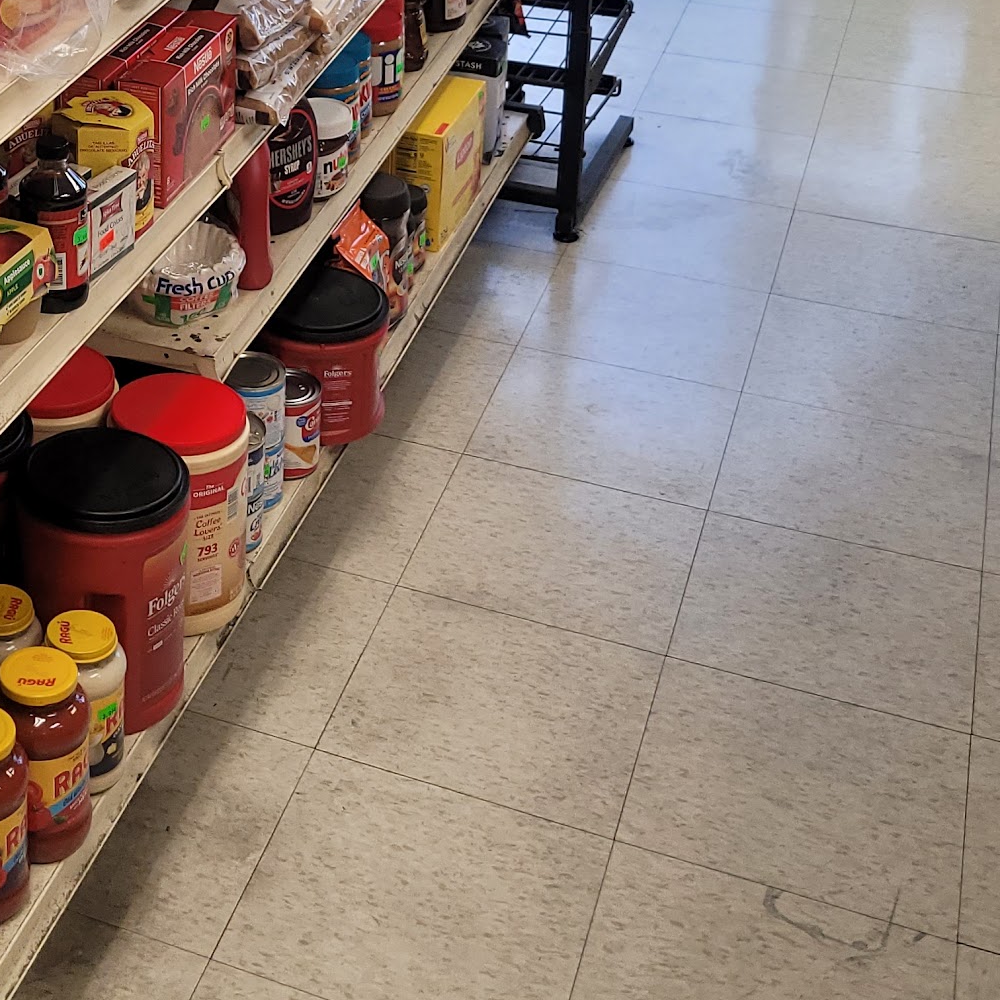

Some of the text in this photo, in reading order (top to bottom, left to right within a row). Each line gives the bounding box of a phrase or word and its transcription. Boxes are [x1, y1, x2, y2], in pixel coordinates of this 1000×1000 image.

[284, 160, 301, 176] SYRUP
[2, 258, 32, 286] Applesauce
[157, 270, 235, 297] Fresh Cup
[323, 369, 352, 379] Folgers
[192, 485, 226, 499] ORIGINAL
[194, 516, 222, 530] Coffee
[197, 543, 218, 558] 793
[147, 616, 174, 638] Classic
